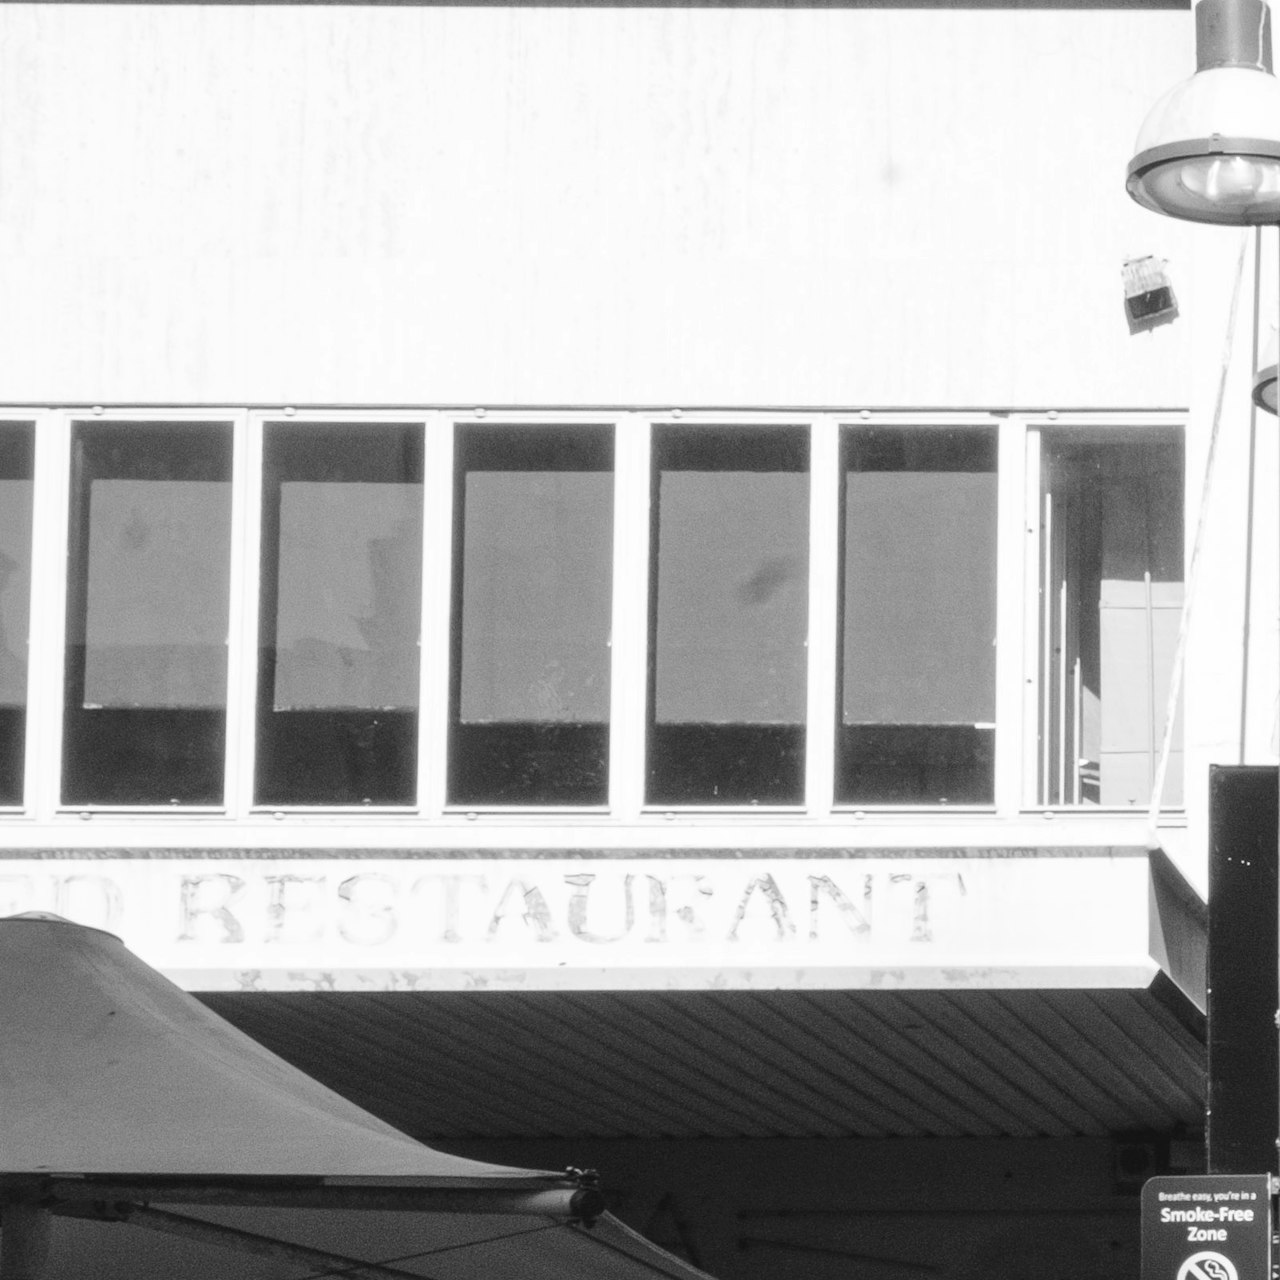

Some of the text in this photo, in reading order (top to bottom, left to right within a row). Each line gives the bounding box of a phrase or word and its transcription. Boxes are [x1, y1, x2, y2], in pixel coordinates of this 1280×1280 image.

[176, 872, 966, 946] RESTAURANT
[1158, 1191, 1191, 1202] Breathe
[1214, 1191, 1240, 1203] you're
[1241, 1191, 1250, 1201] in
[1250, 1192, 1257, 1201] a
[1160, 1206, 1255, 1223] Smoke-Free
[1187, 1226, 1228, 1242] Zone
